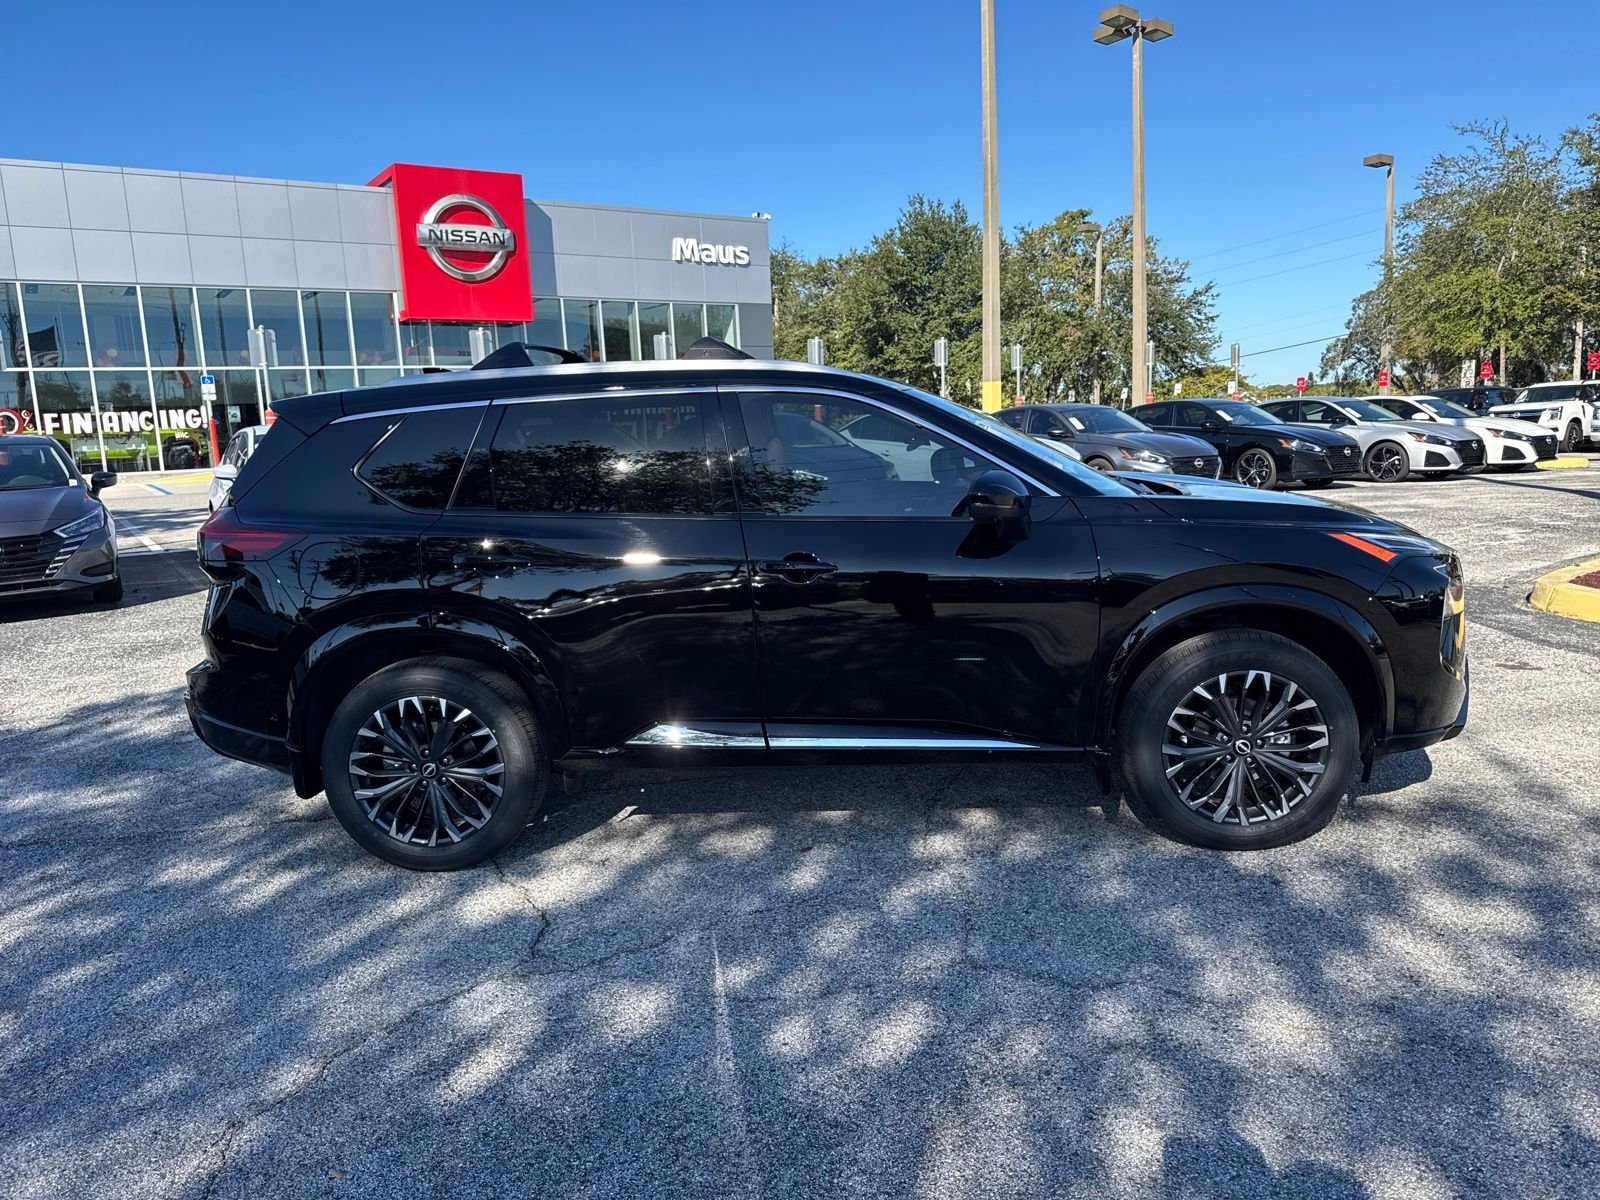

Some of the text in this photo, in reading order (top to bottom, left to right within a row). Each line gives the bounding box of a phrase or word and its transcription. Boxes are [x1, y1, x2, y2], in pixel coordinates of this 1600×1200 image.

[428, 229, 505, 245] NISSAN
[672, 237, 750, 265] Maus
[43, 405, 208, 434] FINANCING!
